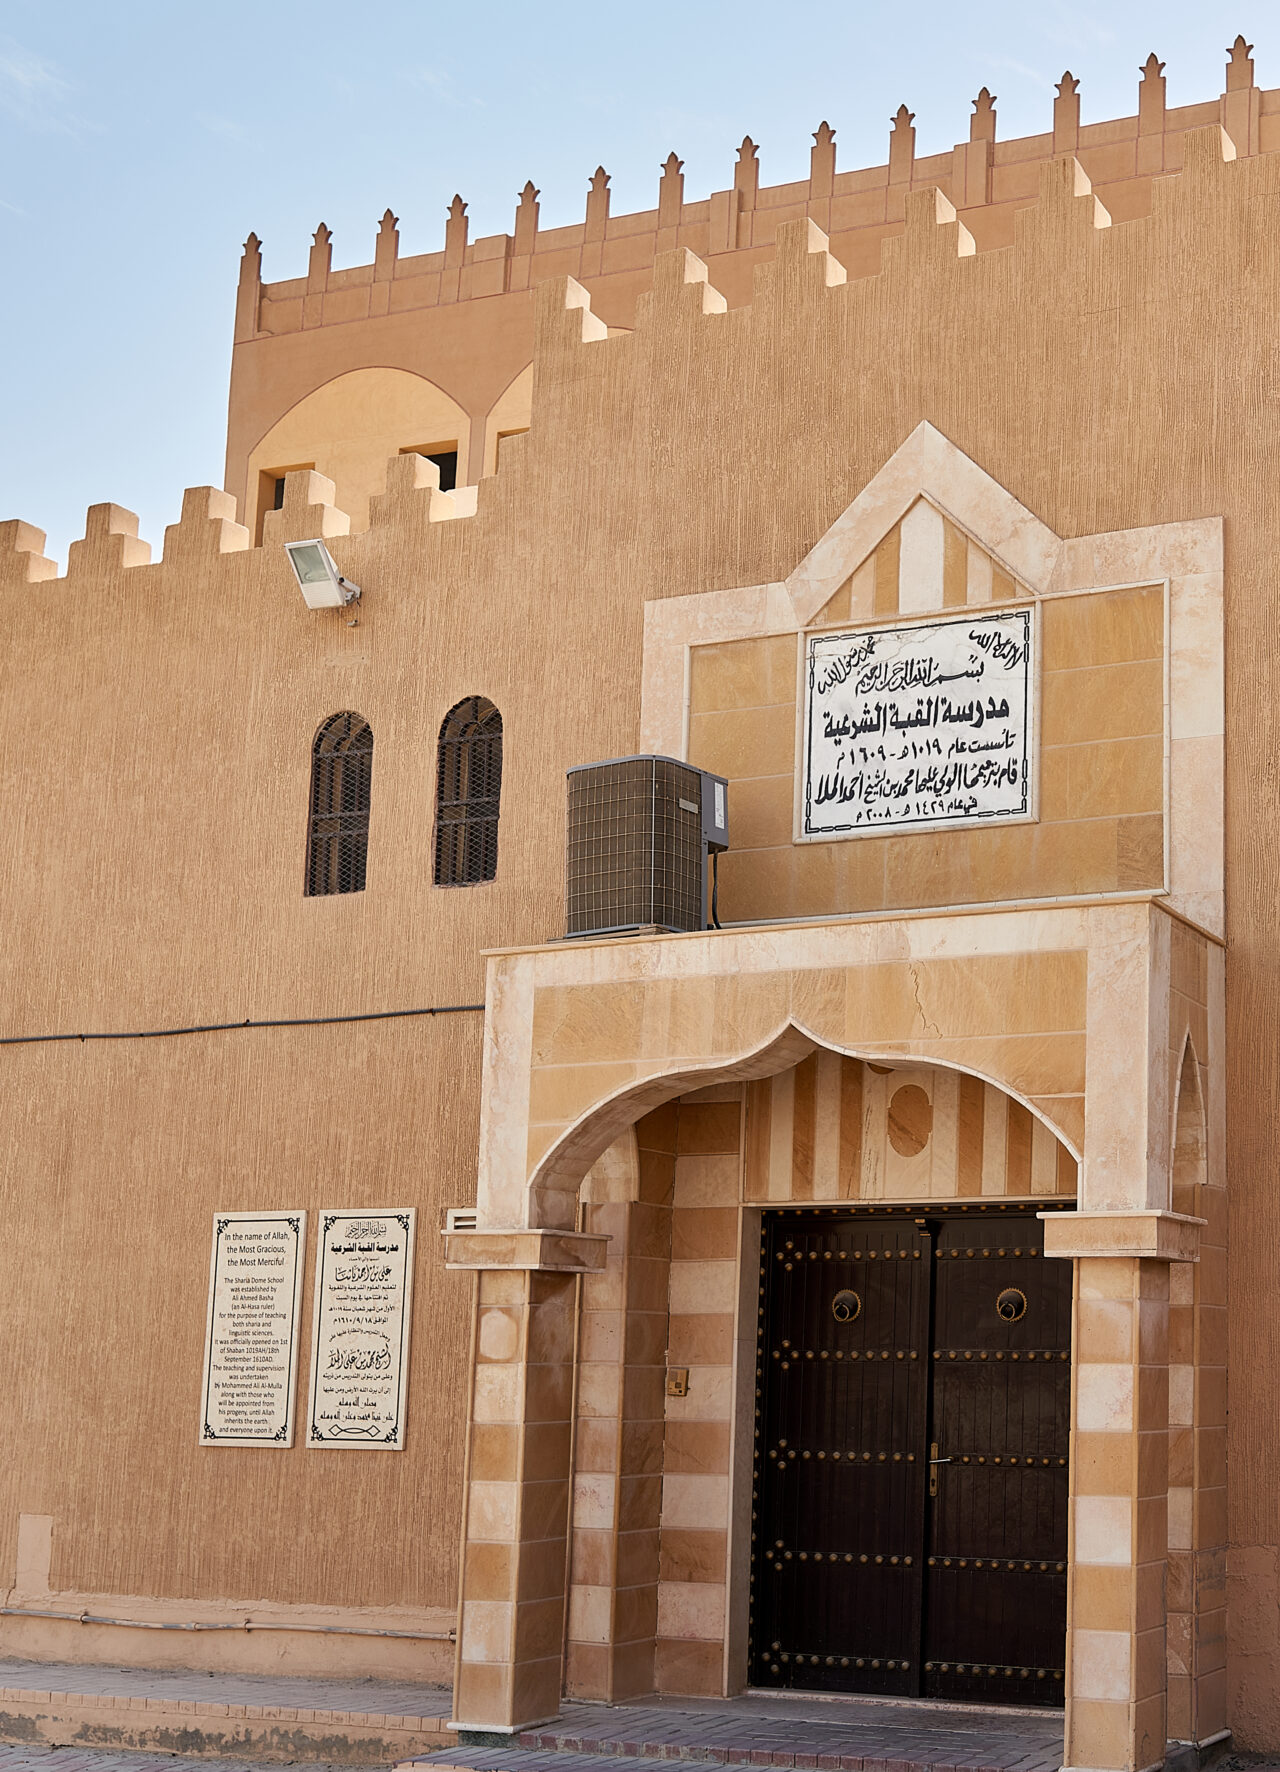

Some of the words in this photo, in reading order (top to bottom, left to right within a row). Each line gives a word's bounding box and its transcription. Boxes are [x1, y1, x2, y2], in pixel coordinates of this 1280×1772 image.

[889, 696, 940, 737] القبة
[942, 695, 1010, 729] مدرسة
[823, 701, 887, 747] الشرعية
[948, 738, 967, 759] عام
[970, 730, 1016, 753] تأسست
[836, 752, 846, 769] م
[915, 765, 939, 794] عليها
[933, 762, 962, 798] الولي
[998, 757, 1017, 789] قام
[814, 772, 844, 805] الملا
[836, 770, 864, 804] أحمد
[864, 769, 887, 804] الشيخ
[883, 778, 899, 797] بن
[893, 768, 914, 798] محمد
[948, 797, 964, 813] عام
[964, 796, 978, 814] في
[856, 812, 862, 823] م
[264, 1232, 270, 1240] of
[272, 1232, 290, 1240] Allah,
[227, 1246, 237, 1254] the
[239, 1246, 255, 1254] Most
[257, 1245, 286, 1254] Gracious,
[330, 1242, 357, 1255] الشرعية
[358, 1242, 375, 1254] القبة
[376, 1242, 399, 1254] مدرسة
[258, 1258, 284, 1266] Merciful
[230, 1338, 251, 1346] officially
[236, 1400, 261, 1408] appointed
